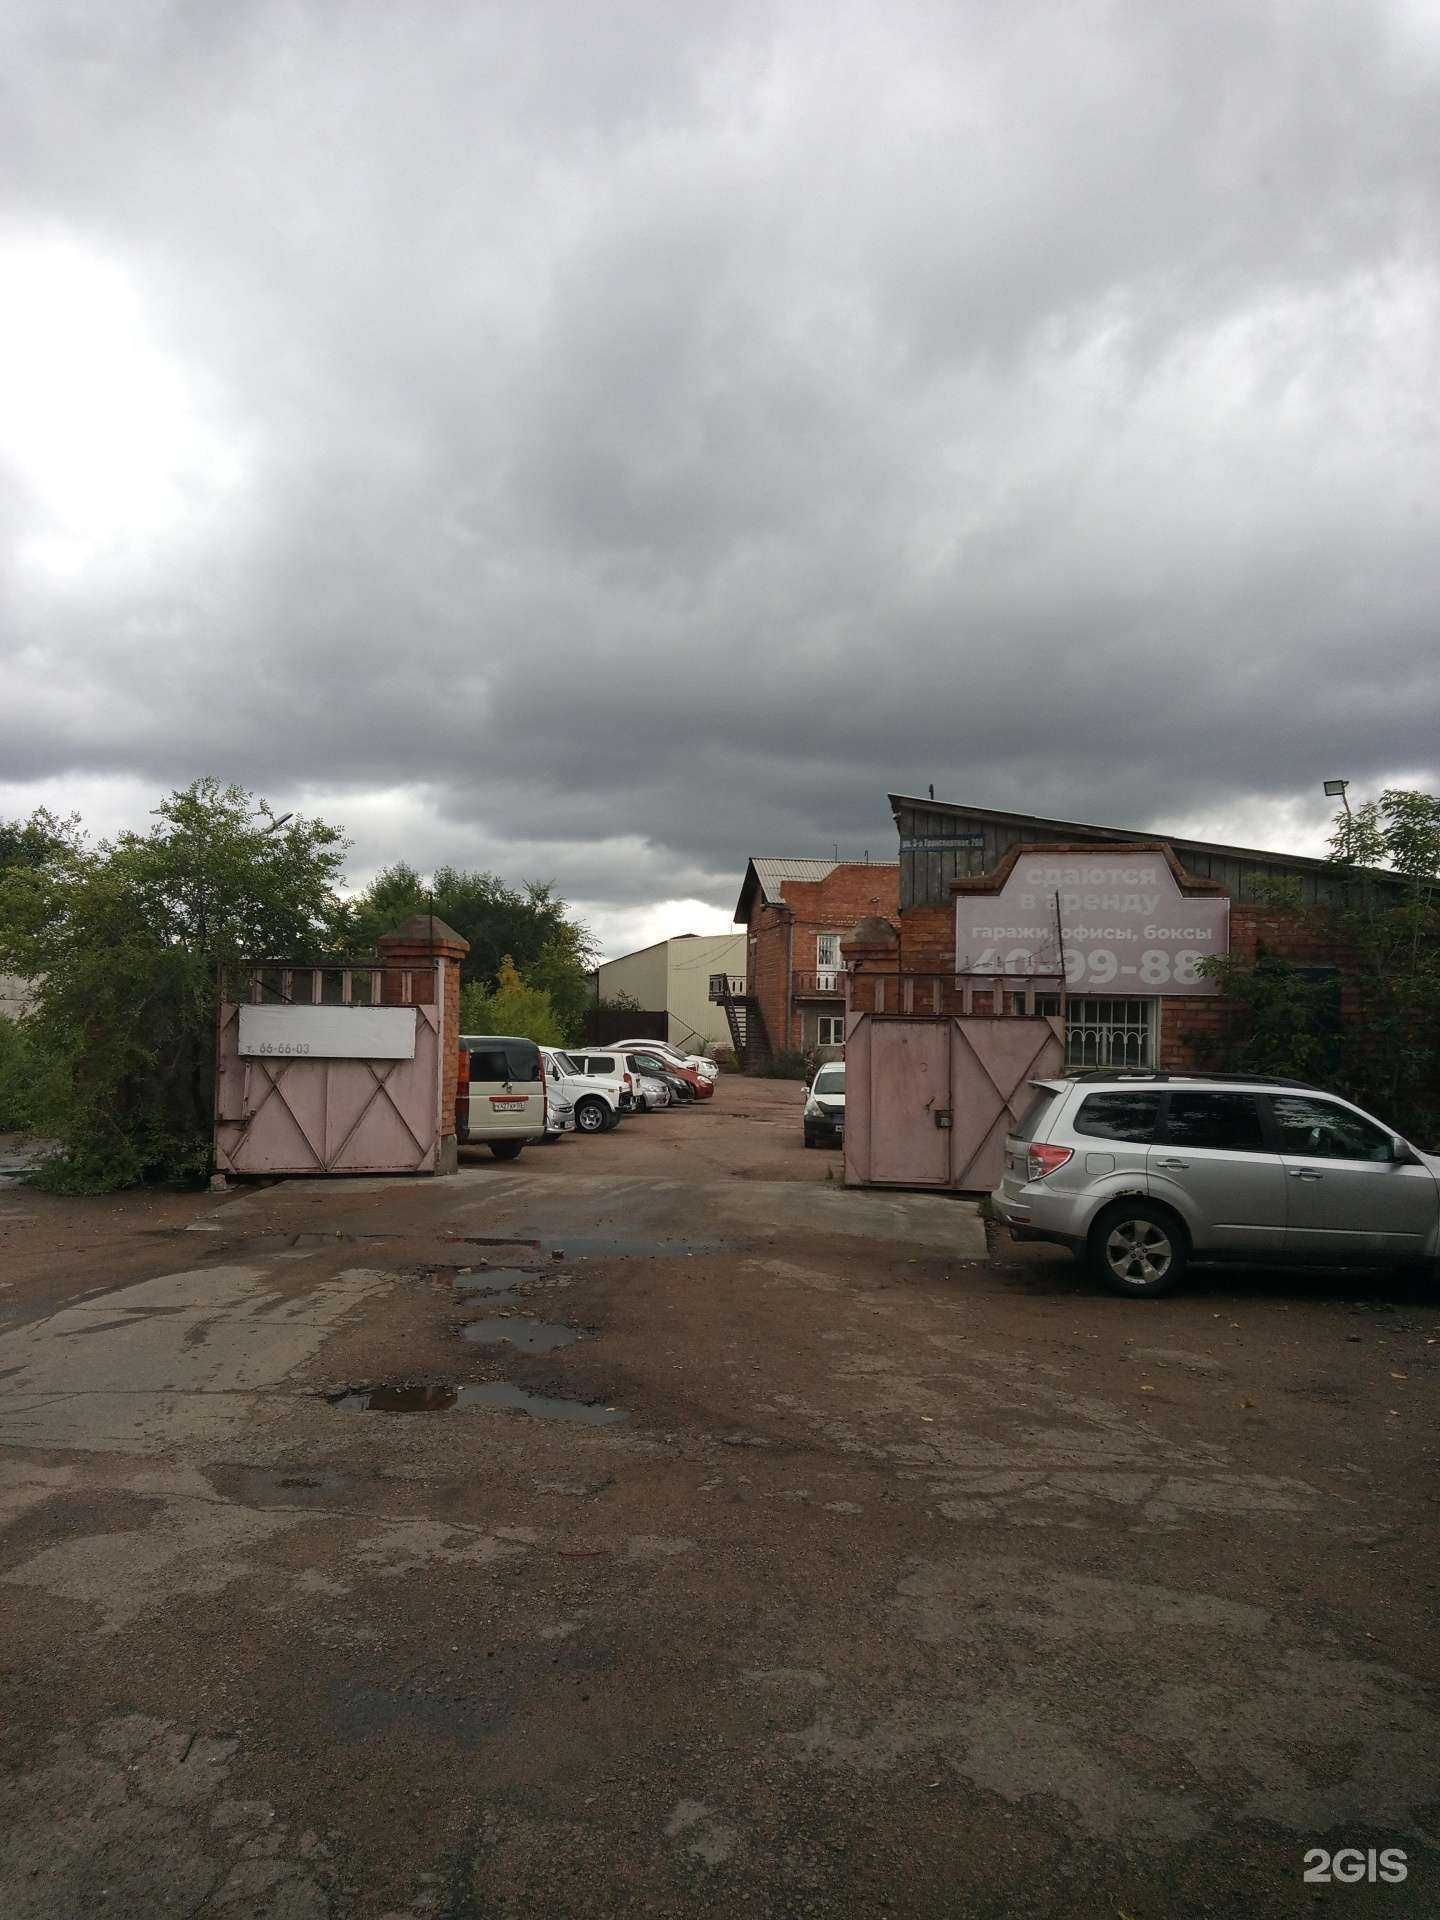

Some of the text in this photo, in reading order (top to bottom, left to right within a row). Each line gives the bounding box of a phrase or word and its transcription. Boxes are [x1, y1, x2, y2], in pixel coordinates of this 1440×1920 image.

[1026, 865, 1157, 887] сдаются
[1021, 895, 1161, 915] в аренду
[972, 924, 1213, 942] гаражи, офисы, боксы
[971, 949, 1204, 985] 40-99-88
[259, 1043, 310, 1054] 66-66-03
